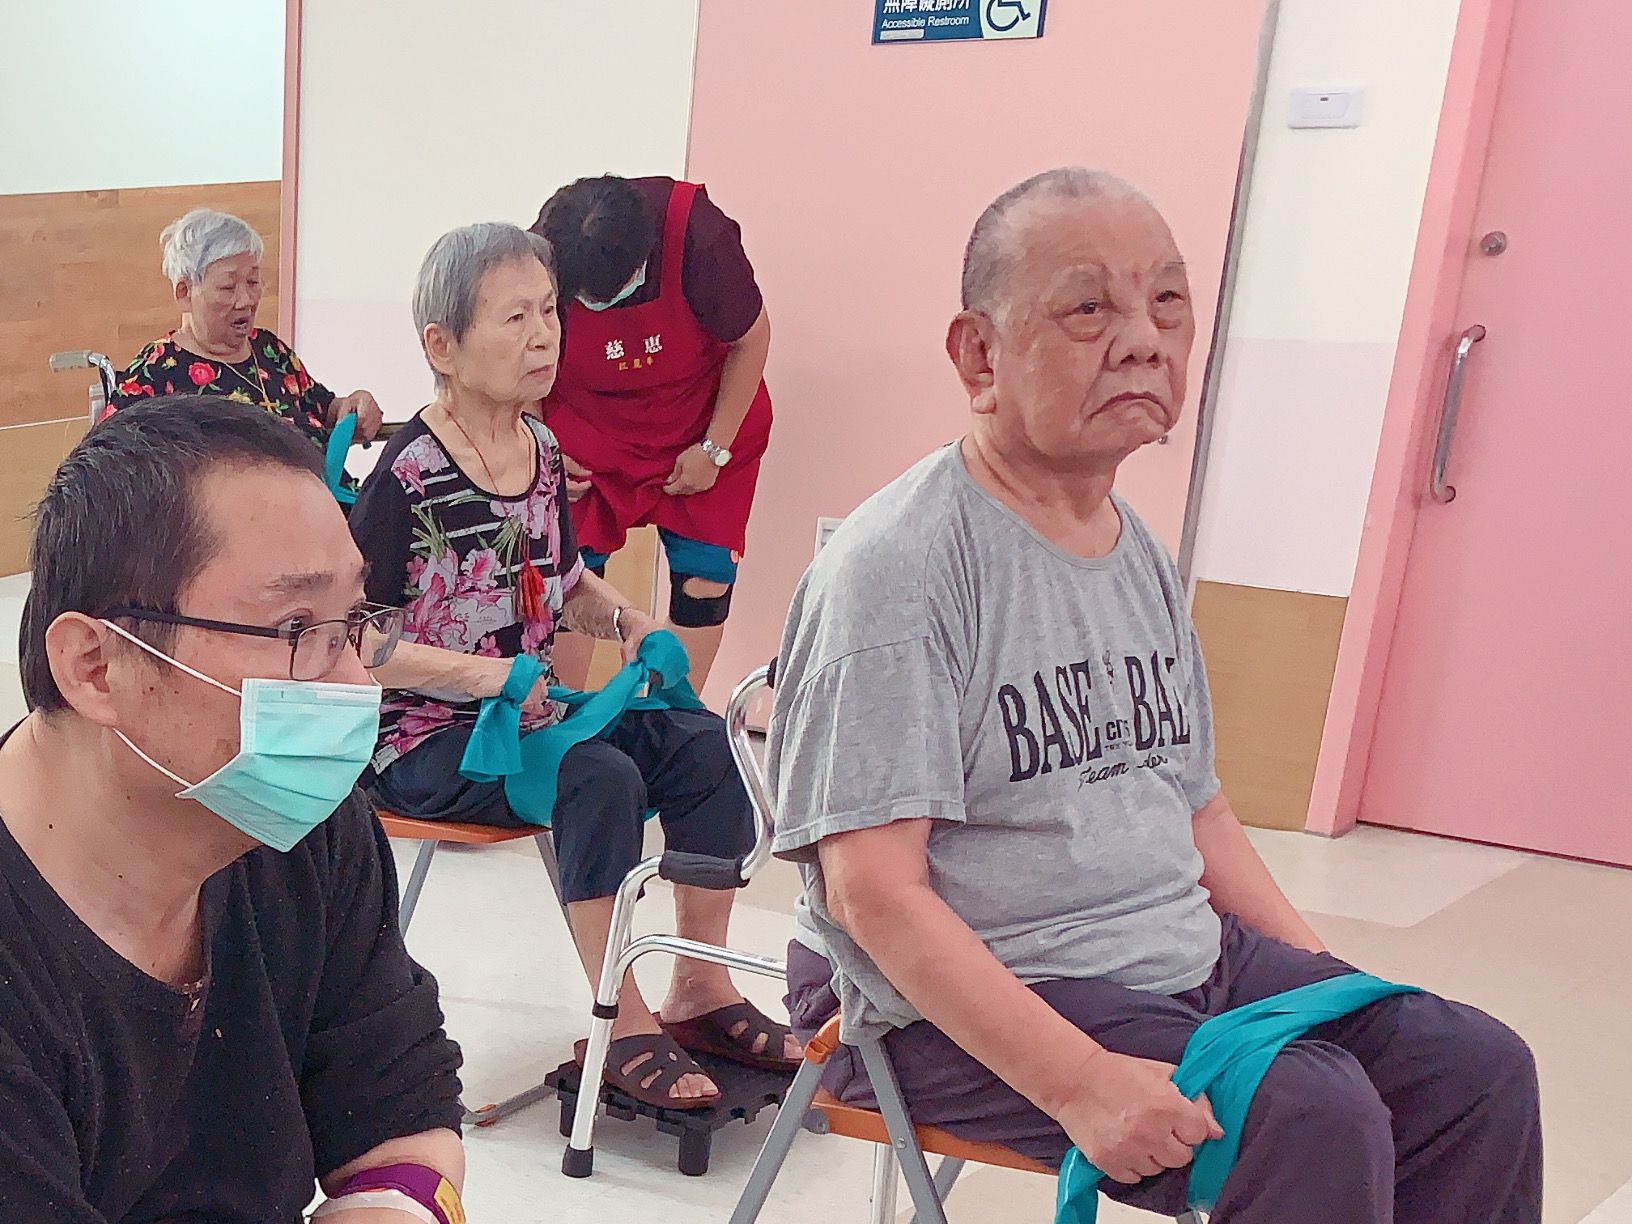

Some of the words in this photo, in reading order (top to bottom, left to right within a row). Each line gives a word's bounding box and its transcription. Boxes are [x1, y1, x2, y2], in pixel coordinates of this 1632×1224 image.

[881, 17, 926, 29] Accessible
[928, 16, 970, 27] Restroom
[997, 659, 1103, 783] BASE
[1077, 762, 1130, 793] Team
